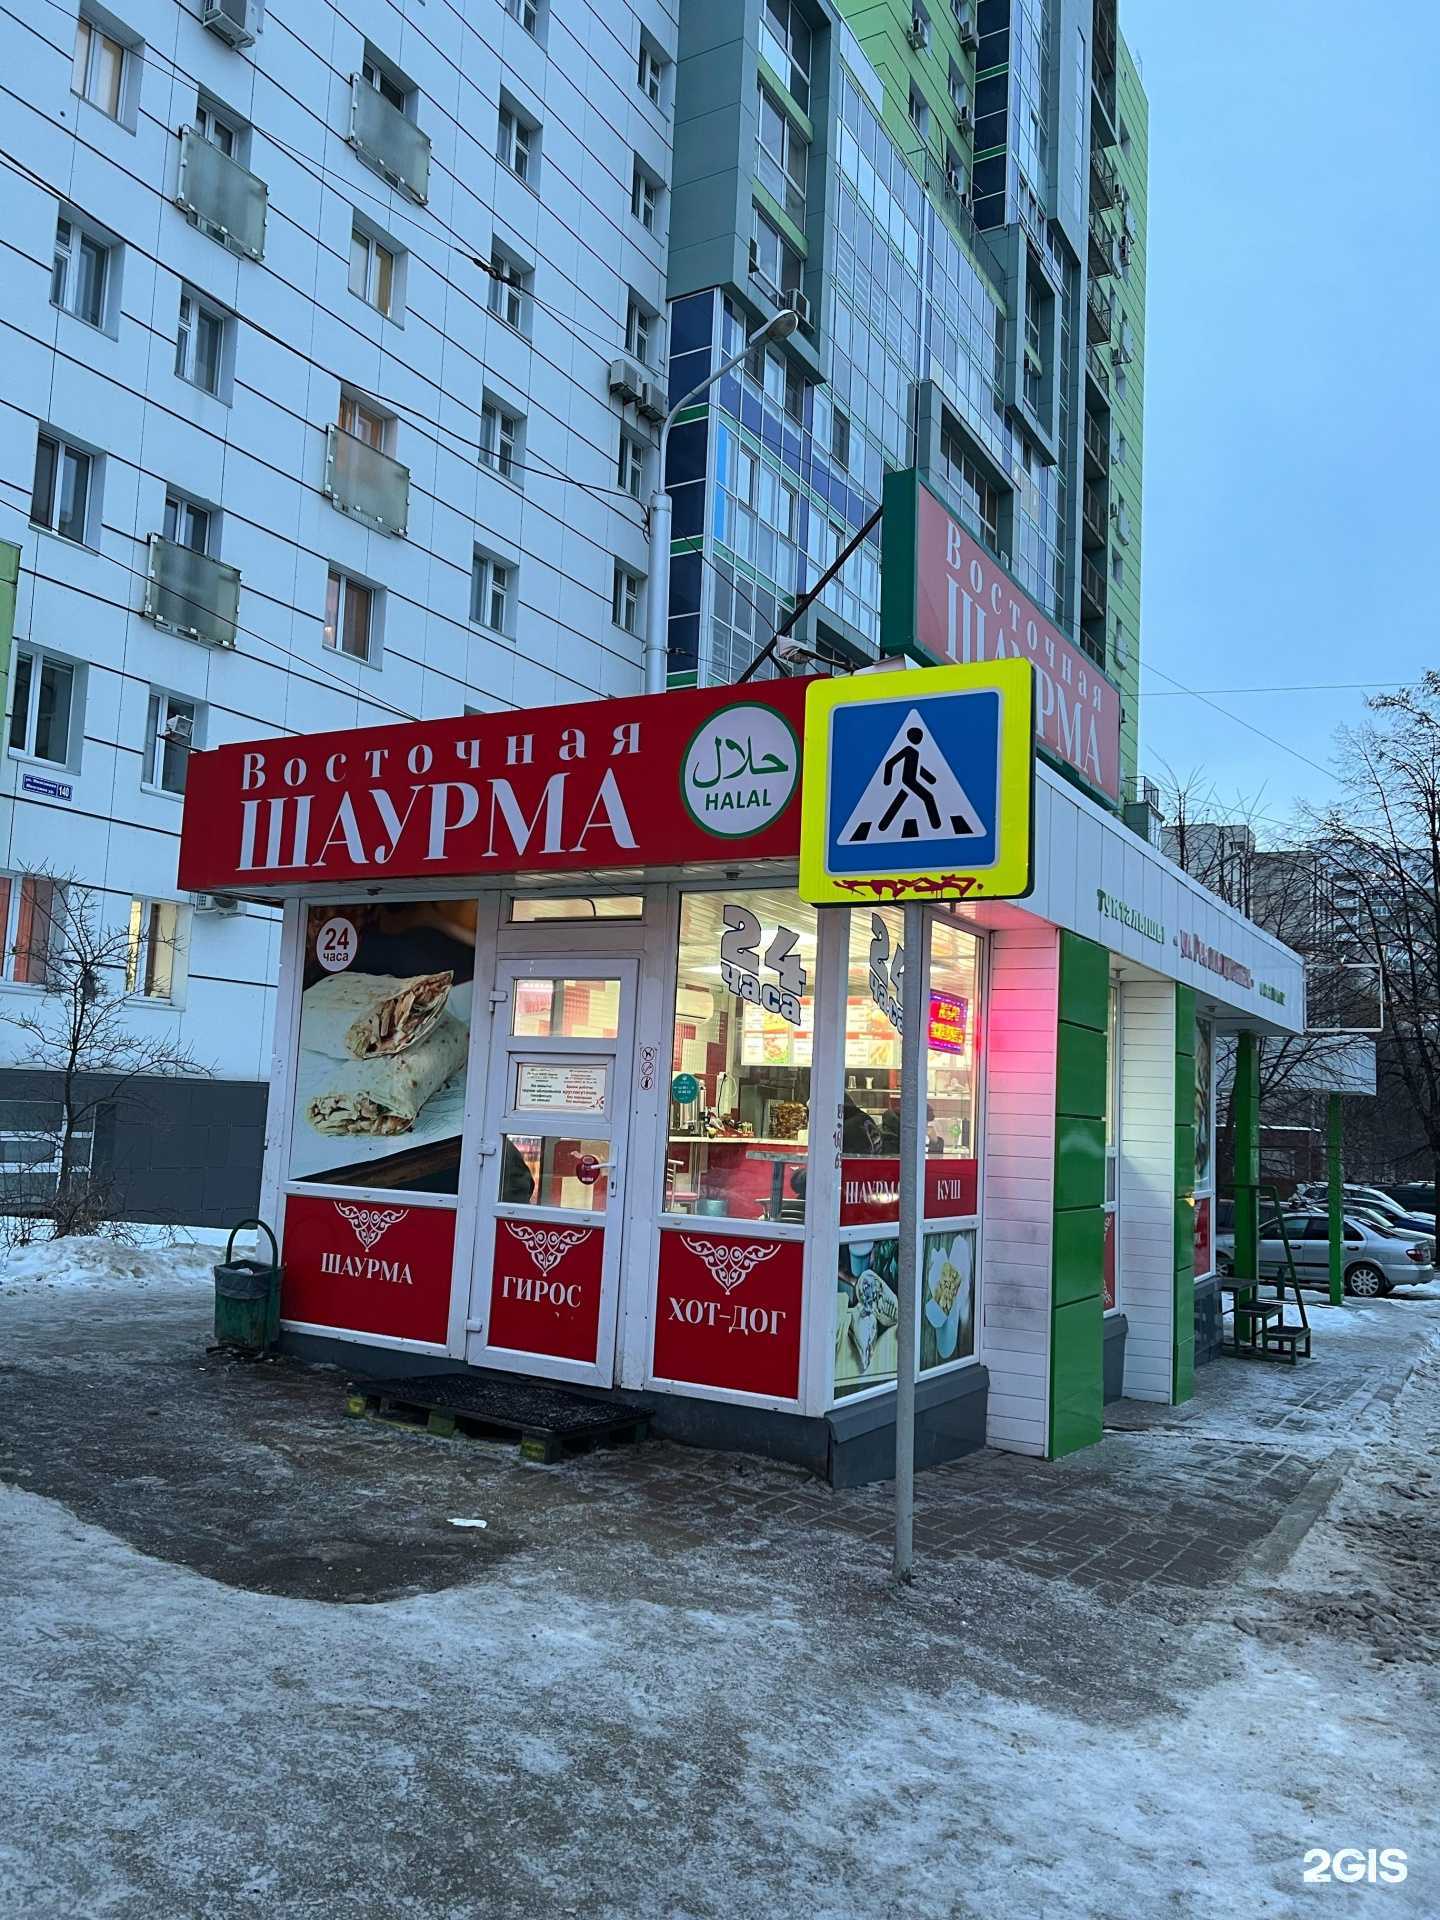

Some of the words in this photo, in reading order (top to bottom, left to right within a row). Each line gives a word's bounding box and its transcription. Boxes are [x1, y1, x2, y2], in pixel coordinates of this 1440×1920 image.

[946, 519, 1102, 712] Восточная
[242, 721, 641, 791] Восточная
[692, 735, 789, 788] حلال
[705, 789, 772, 811] HALAL
[235, 767, 641, 871] ШАУРМА
[323, 952, 349, 962] часа
[324, 927, 350, 950] 24
[720, 904, 807, 997] 24
[720, 961, 803, 1026] часа
[845, 1180, 901, 1205] ШАУРМ
[937, 1179, 961, 1201] КУШ
[321, 1252, 415, 1285] ШАУРМА
[501, 1275, 583, 1309] ГИРОС
[667, 1296, 788, 1336] ХОТ-ДОГ
